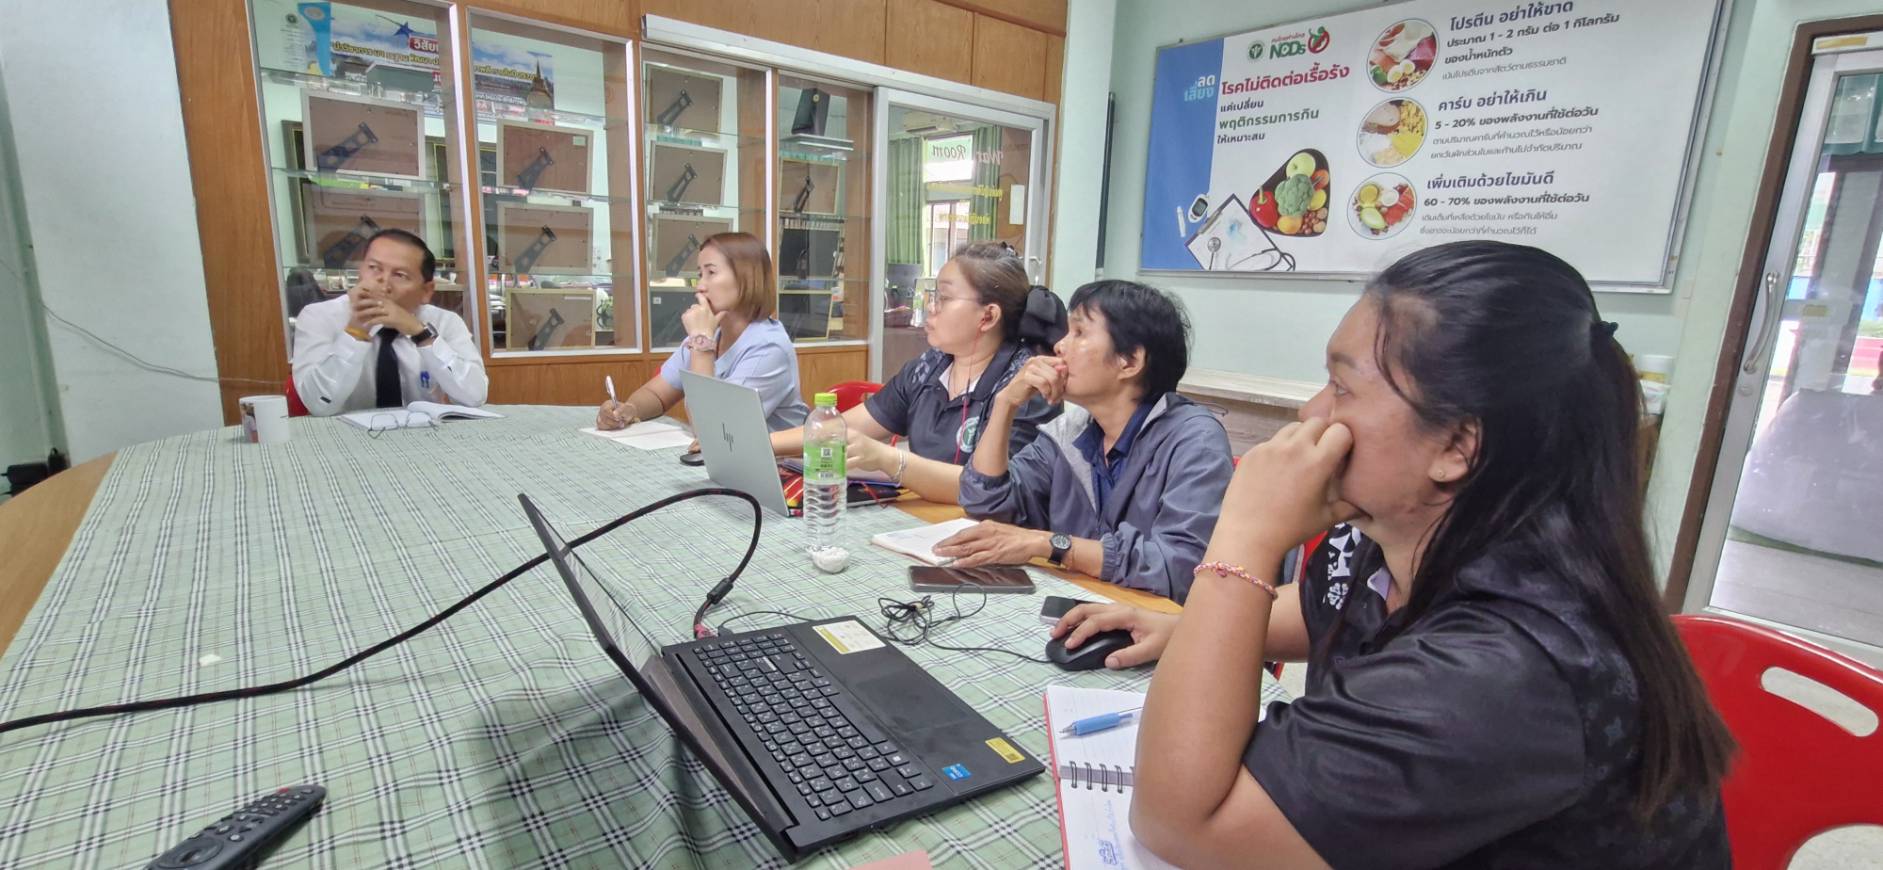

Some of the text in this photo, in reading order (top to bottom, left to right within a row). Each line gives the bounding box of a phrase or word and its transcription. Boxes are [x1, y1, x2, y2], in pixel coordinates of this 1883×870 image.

[1450, 1, 1574, 31] โปรตีน อย่าให้ขาด
[1447, 34, 1487, 48] ประมาณ
[1490, 32, 1495, 41] 1
[1506, 29, 1514, 39] 2
[1517, 24, 1540, 37] กรัม
[1543, 21, 1560, 33] ต่อ
[1564, 20, 1569, 30] 1
[1573, 13, 1620, 29] กิโลกรัม
[1444, 47, 1513, 65] ของน้ำหนักตัว
[1197, 74, 1216, 88] ลด
[1222, 63, 1350, 95] โรคไม่ติดต่อเรื้อรัง
[1184, 80, 1215, 102] เสี่ยง
[1438, 88, 1548, 112] คาร์บ อย่าให้เกิน
[1220, 97, 1264, 113] แค่เปลี่ยน
[1219, 108, 1320, 131] พฤติกรรมการกิน
[1434, 120, 1442, 130] 5
[1452, 118, 1476, 129] 20%
[1479, 106, 1599, 127] ของพลังงานที่ใช้ต่อวัน
[1217, 131, 1265, 145] ให้เหมาะสม
[1427, 170, 1555, 190] เพิ่มเติมด้วยไขมันดี
[1424, 198, 1438, 207] 60
[1448, 197, 1471, 207] 70%
[1473, 191, 1591, 206] ของพลังงานที่ใช้ต่อวัน
